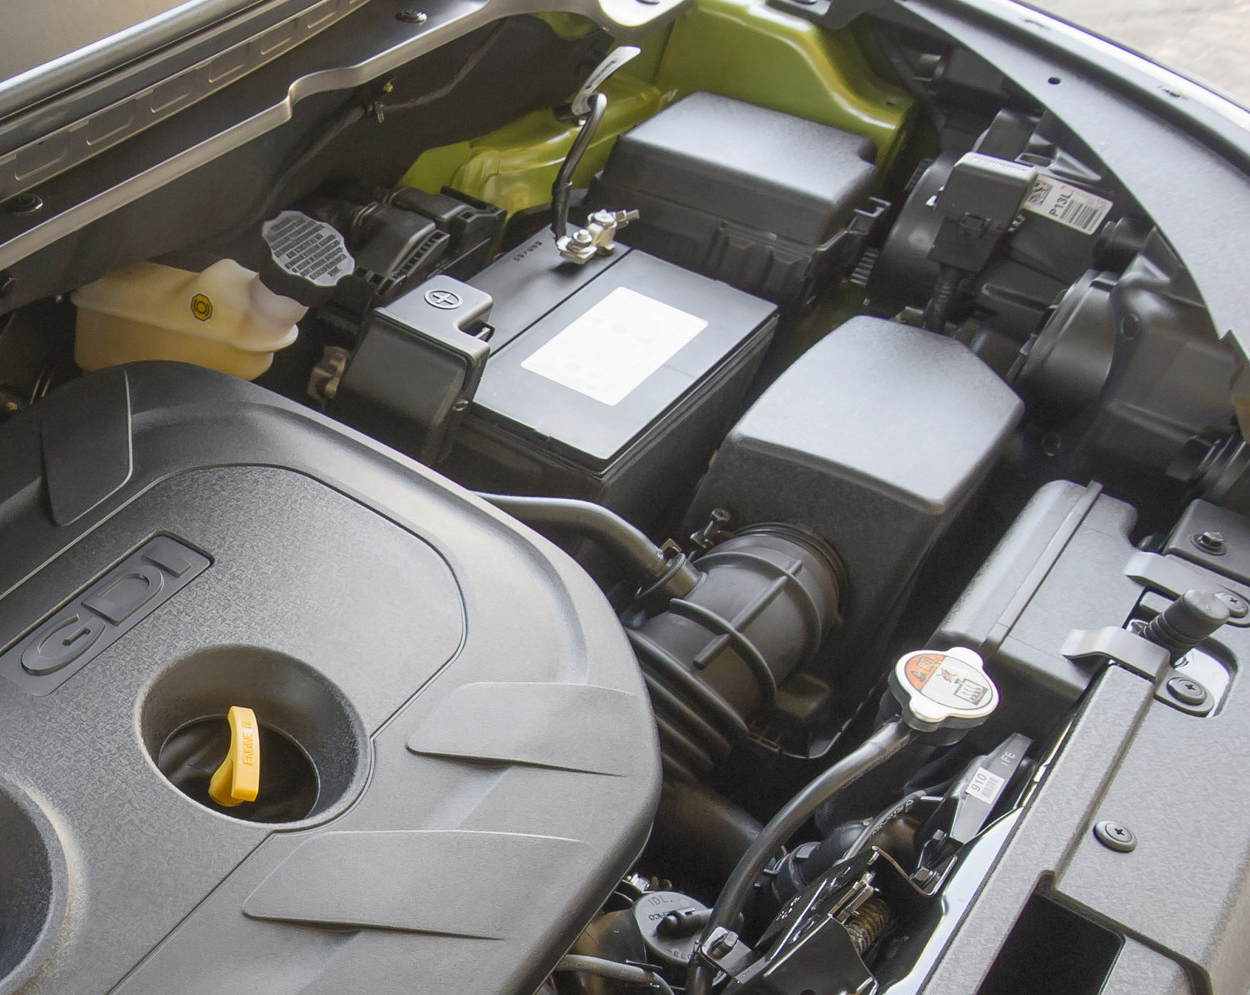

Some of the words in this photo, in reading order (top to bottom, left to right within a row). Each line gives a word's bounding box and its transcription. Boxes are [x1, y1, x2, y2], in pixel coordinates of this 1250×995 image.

[1048, 191, 1072, 218] P13L
[20, 548, 192, 677] GDI
[971, 772, 987, 792] 910
